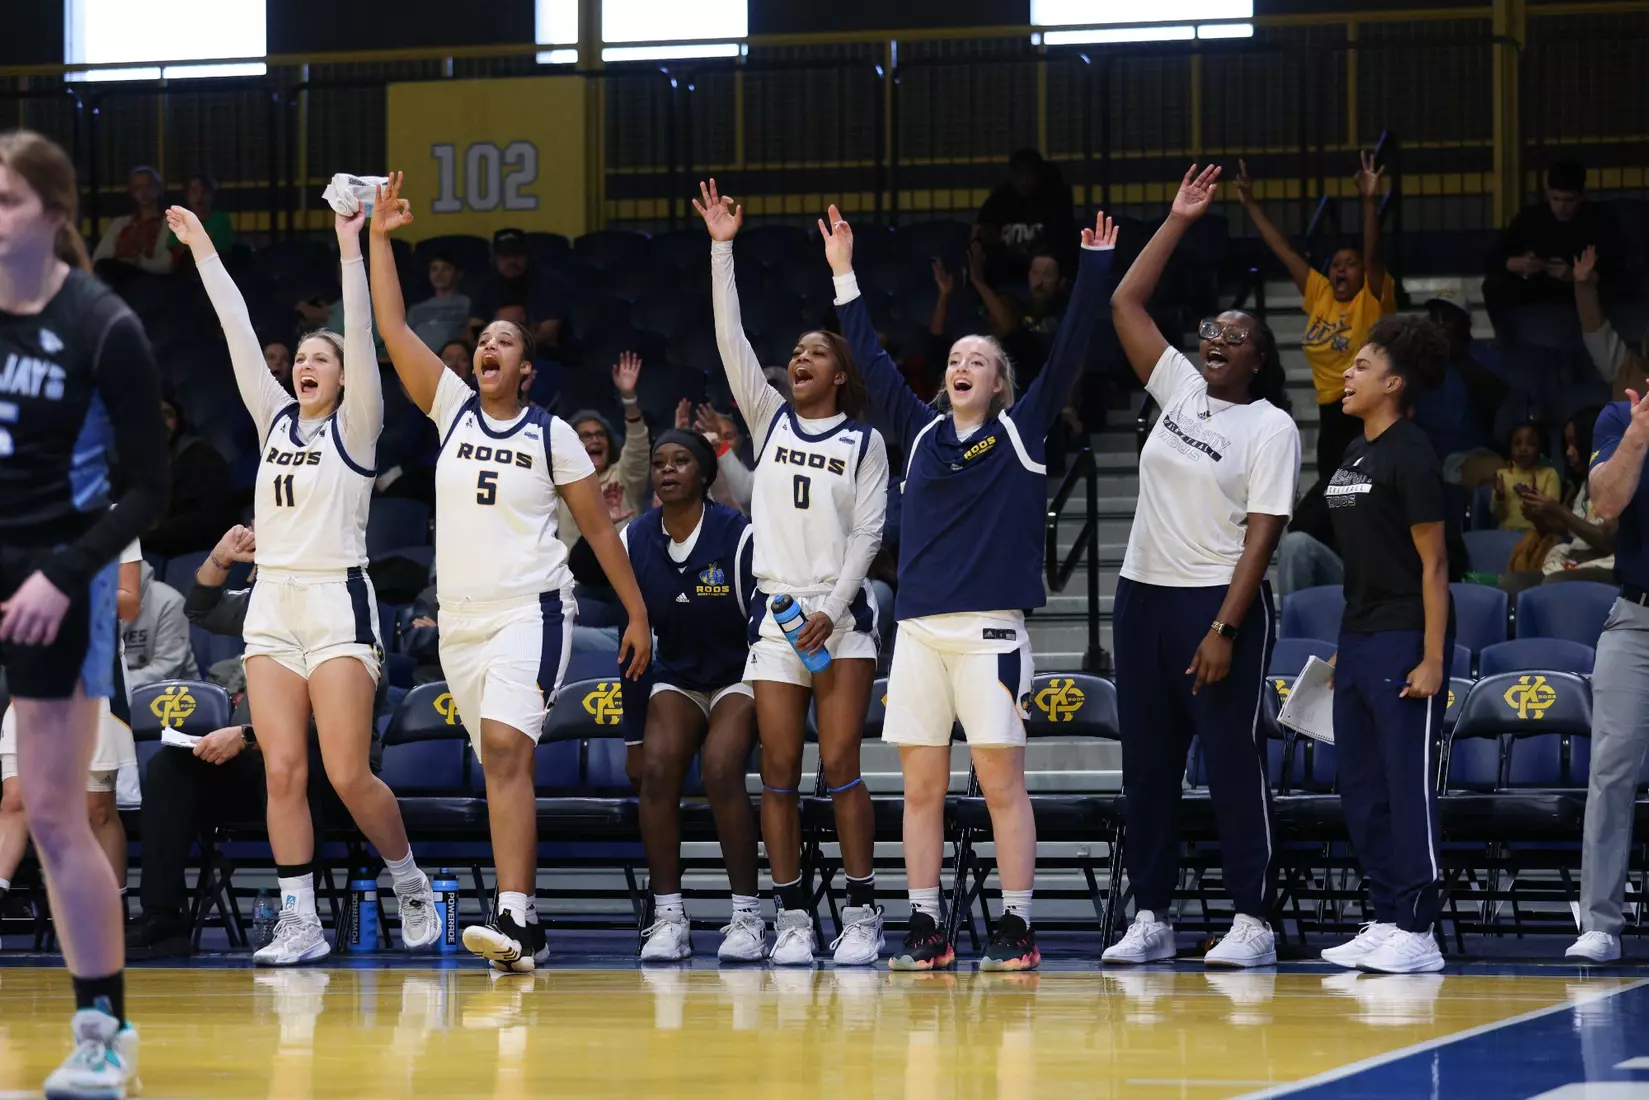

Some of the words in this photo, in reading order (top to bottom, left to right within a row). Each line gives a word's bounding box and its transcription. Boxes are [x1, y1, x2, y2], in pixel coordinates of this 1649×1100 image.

[431, 140, 539, 213] 102
[266, 447, 322, 466] ROOS
[456, 442, 534, 469] ROOS
[774, 446, 846, 476] ROOS
[963, 435, 996, 460] ROOS
[273, 474, 295, 507] 11
[476, 470, 499, 506] 5
[793, 474, 812, 510] 0
[696, 585, 730, 593] ROOS
[351, 893, 359, 944] POWERADE
[447, 892, 455, 943] POWERADE
